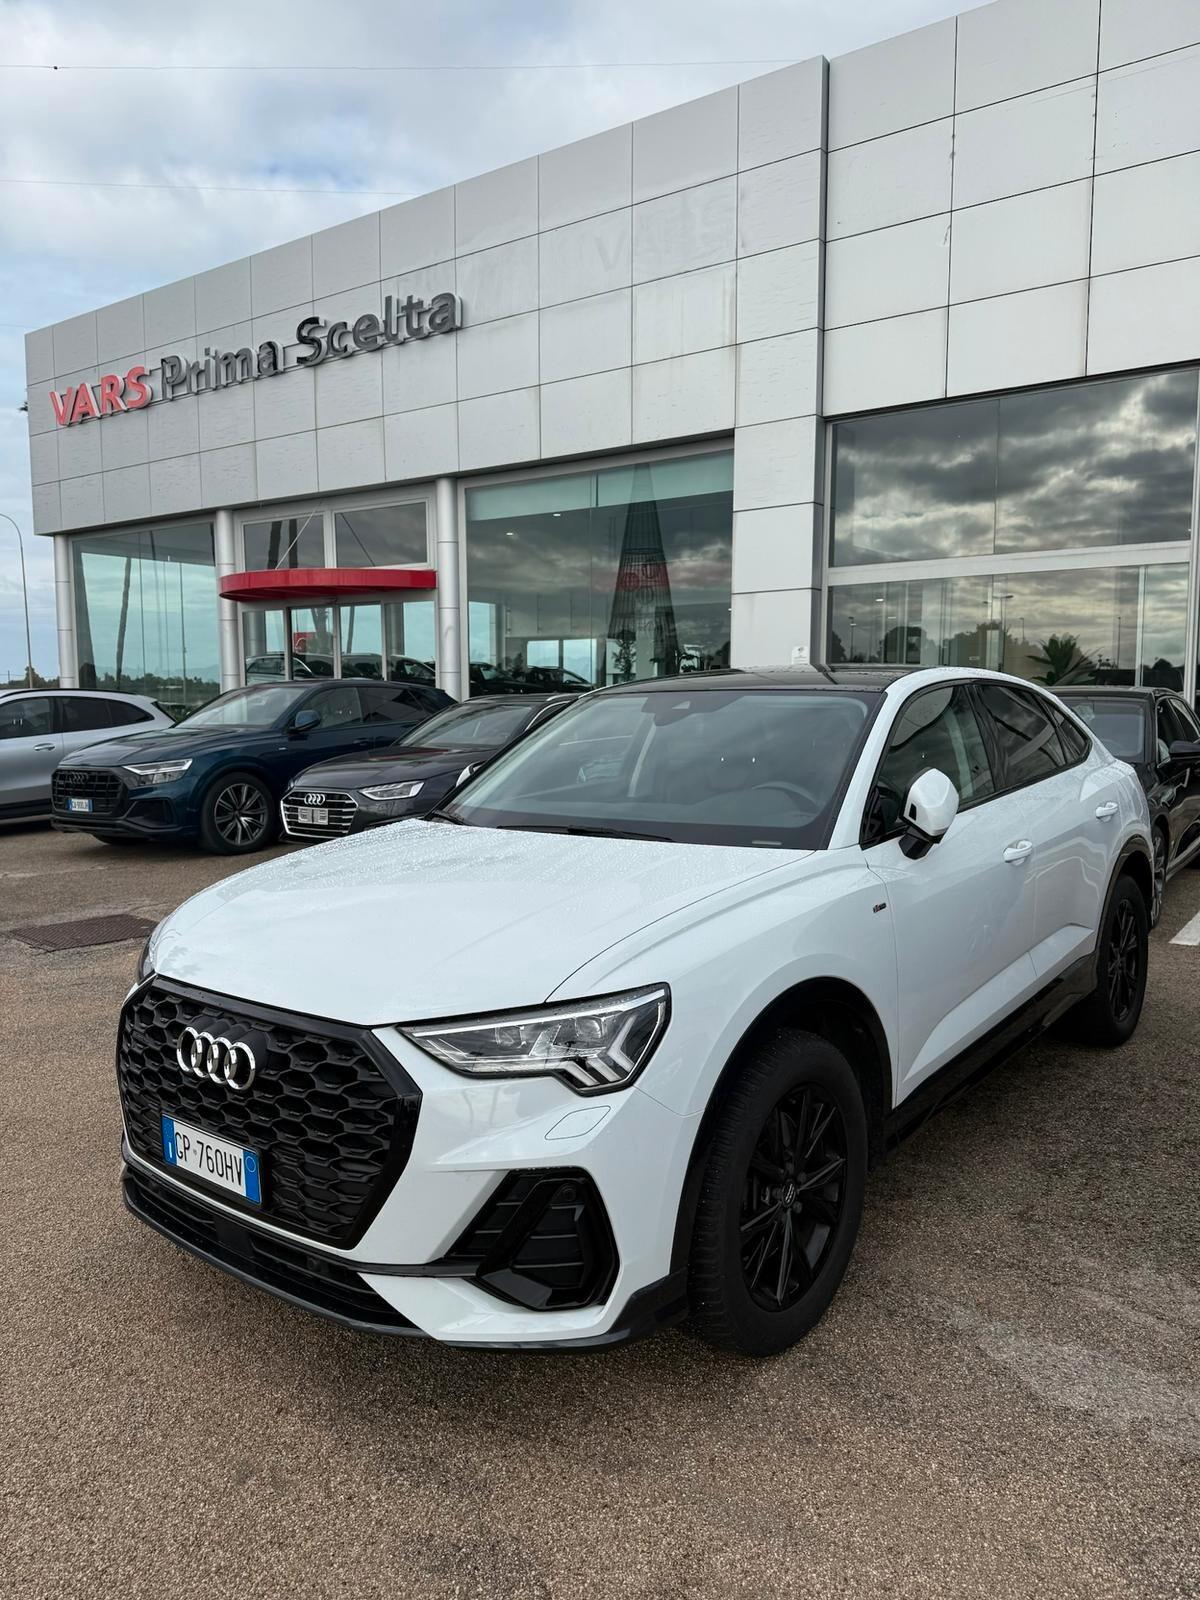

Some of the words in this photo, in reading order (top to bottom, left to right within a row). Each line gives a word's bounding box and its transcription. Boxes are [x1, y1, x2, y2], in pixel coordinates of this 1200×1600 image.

[50, 364, 153, 426] VARS
[160, 338, 284, 400] Prima
[296, 291, 461, 367] Scelta
[196, 1140, 242, 1186] 760HV
